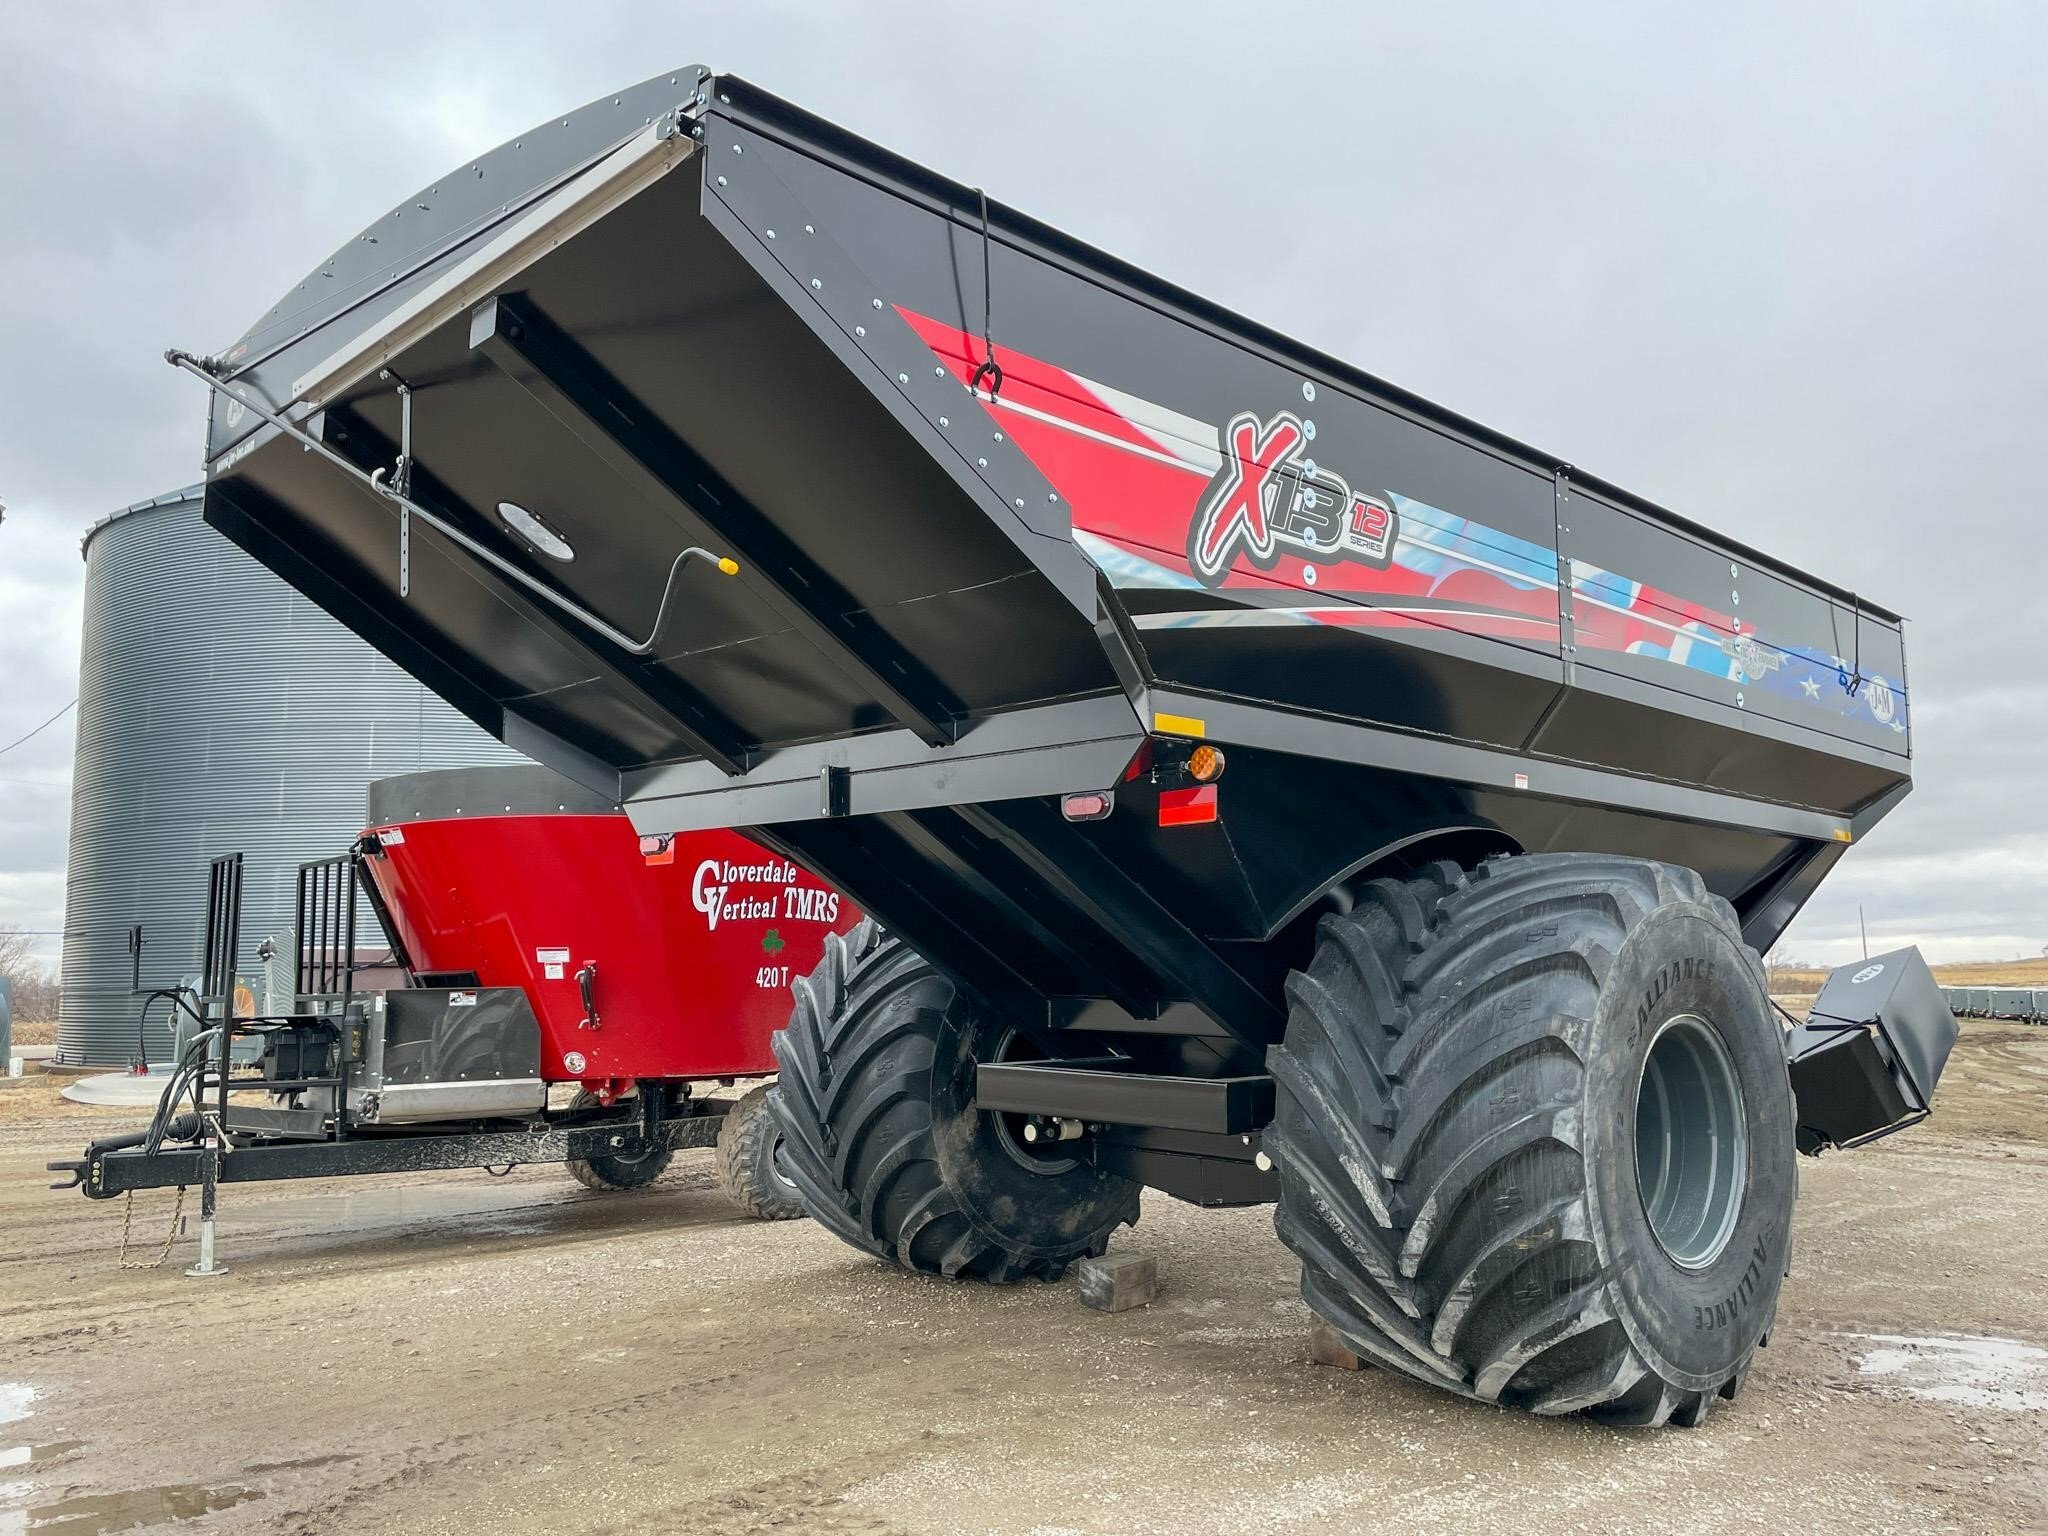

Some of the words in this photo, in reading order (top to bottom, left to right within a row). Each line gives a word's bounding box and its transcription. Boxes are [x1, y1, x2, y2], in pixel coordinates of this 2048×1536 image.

[1352, 501, 1387, 539] 12
[1350, 535, 1383, 553] SERIES
[703, 885, 778, 931] Vertical
[783, 886, 839, 923] TMRS
[755, 966, 779, 988] 420
[781, 966, 789, 987] T
[1638, 957, 1715, 1037] ALLIANCE
[1694, 1234, 1767, 1331] ALLIANCE
